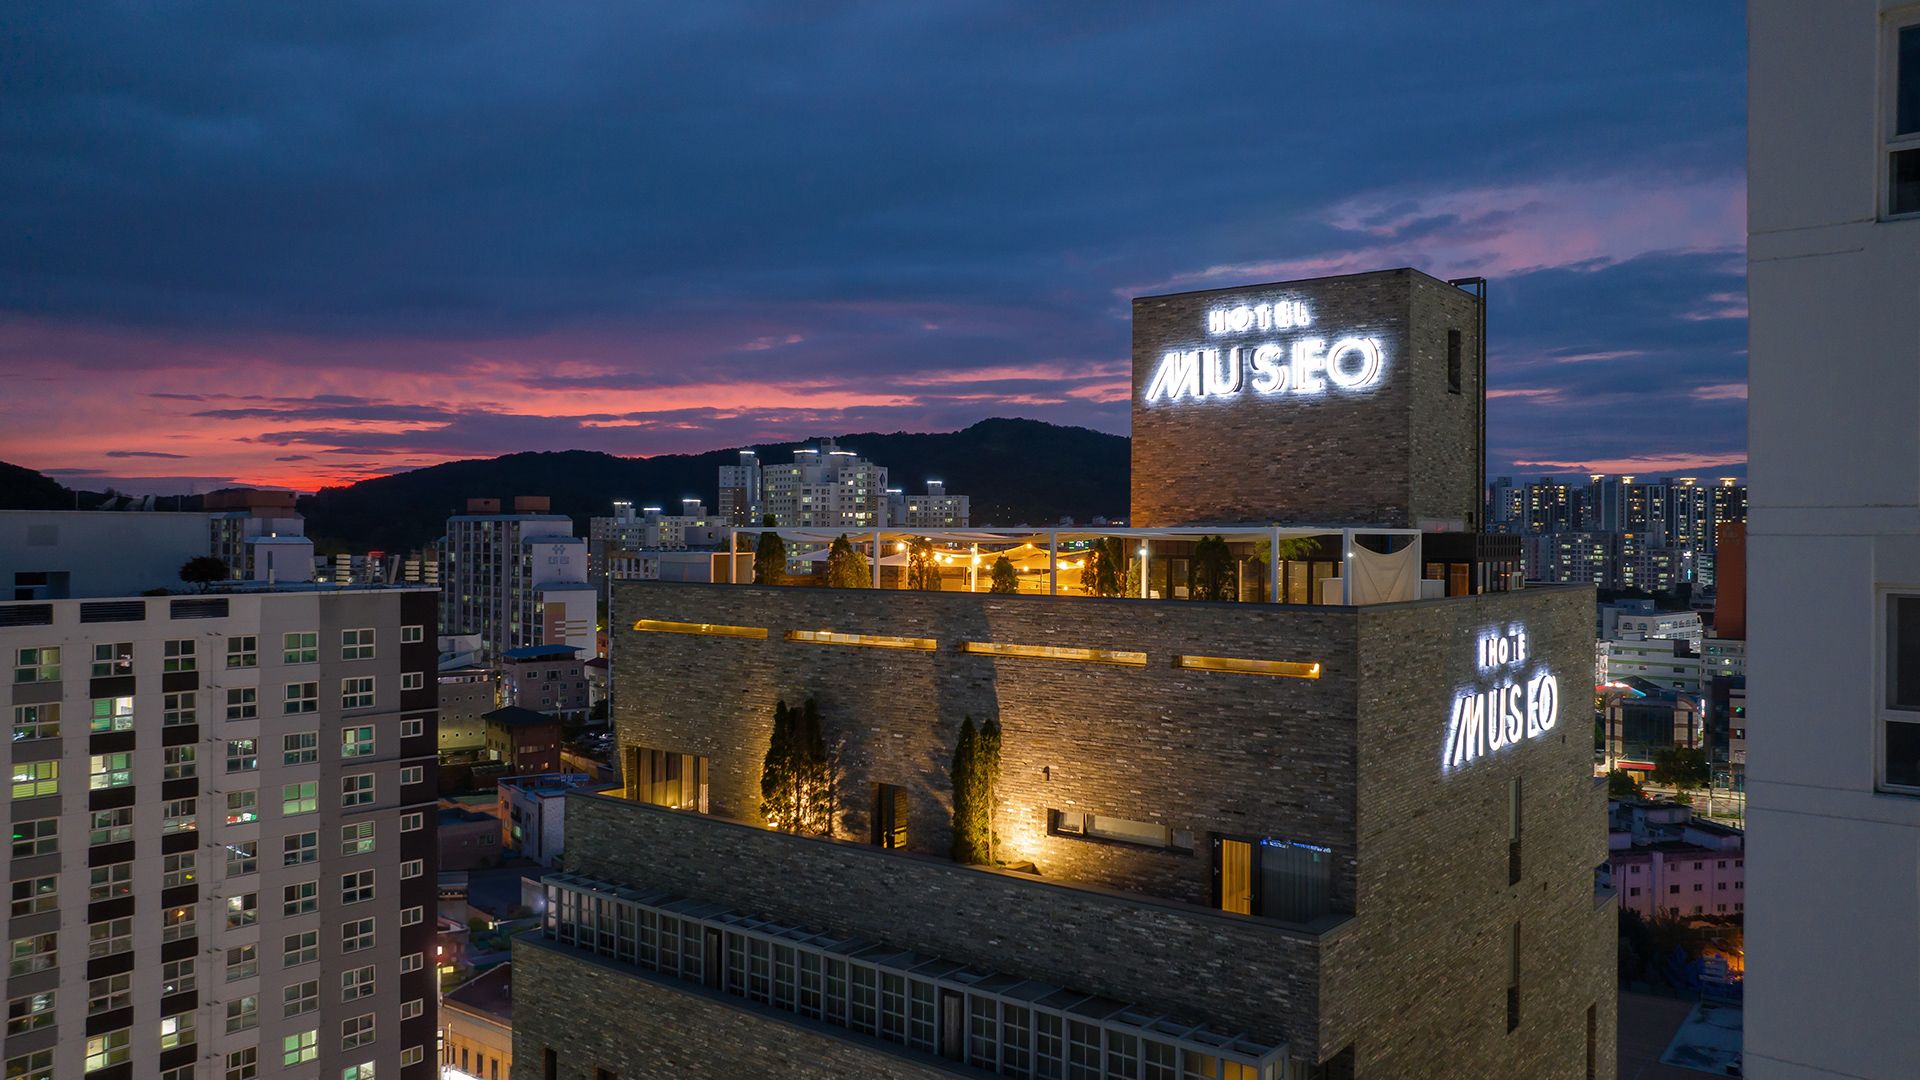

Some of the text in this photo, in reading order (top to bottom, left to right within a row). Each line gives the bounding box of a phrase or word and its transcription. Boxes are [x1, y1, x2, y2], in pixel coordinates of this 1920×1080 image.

[1208, 301, 1310, 333] HOTEL
[1145, 337, 1382, 401] MUSEO
[1487, 633, 1527, 667] HOTE
[1450, 675, 1558, 767] MUSEO
